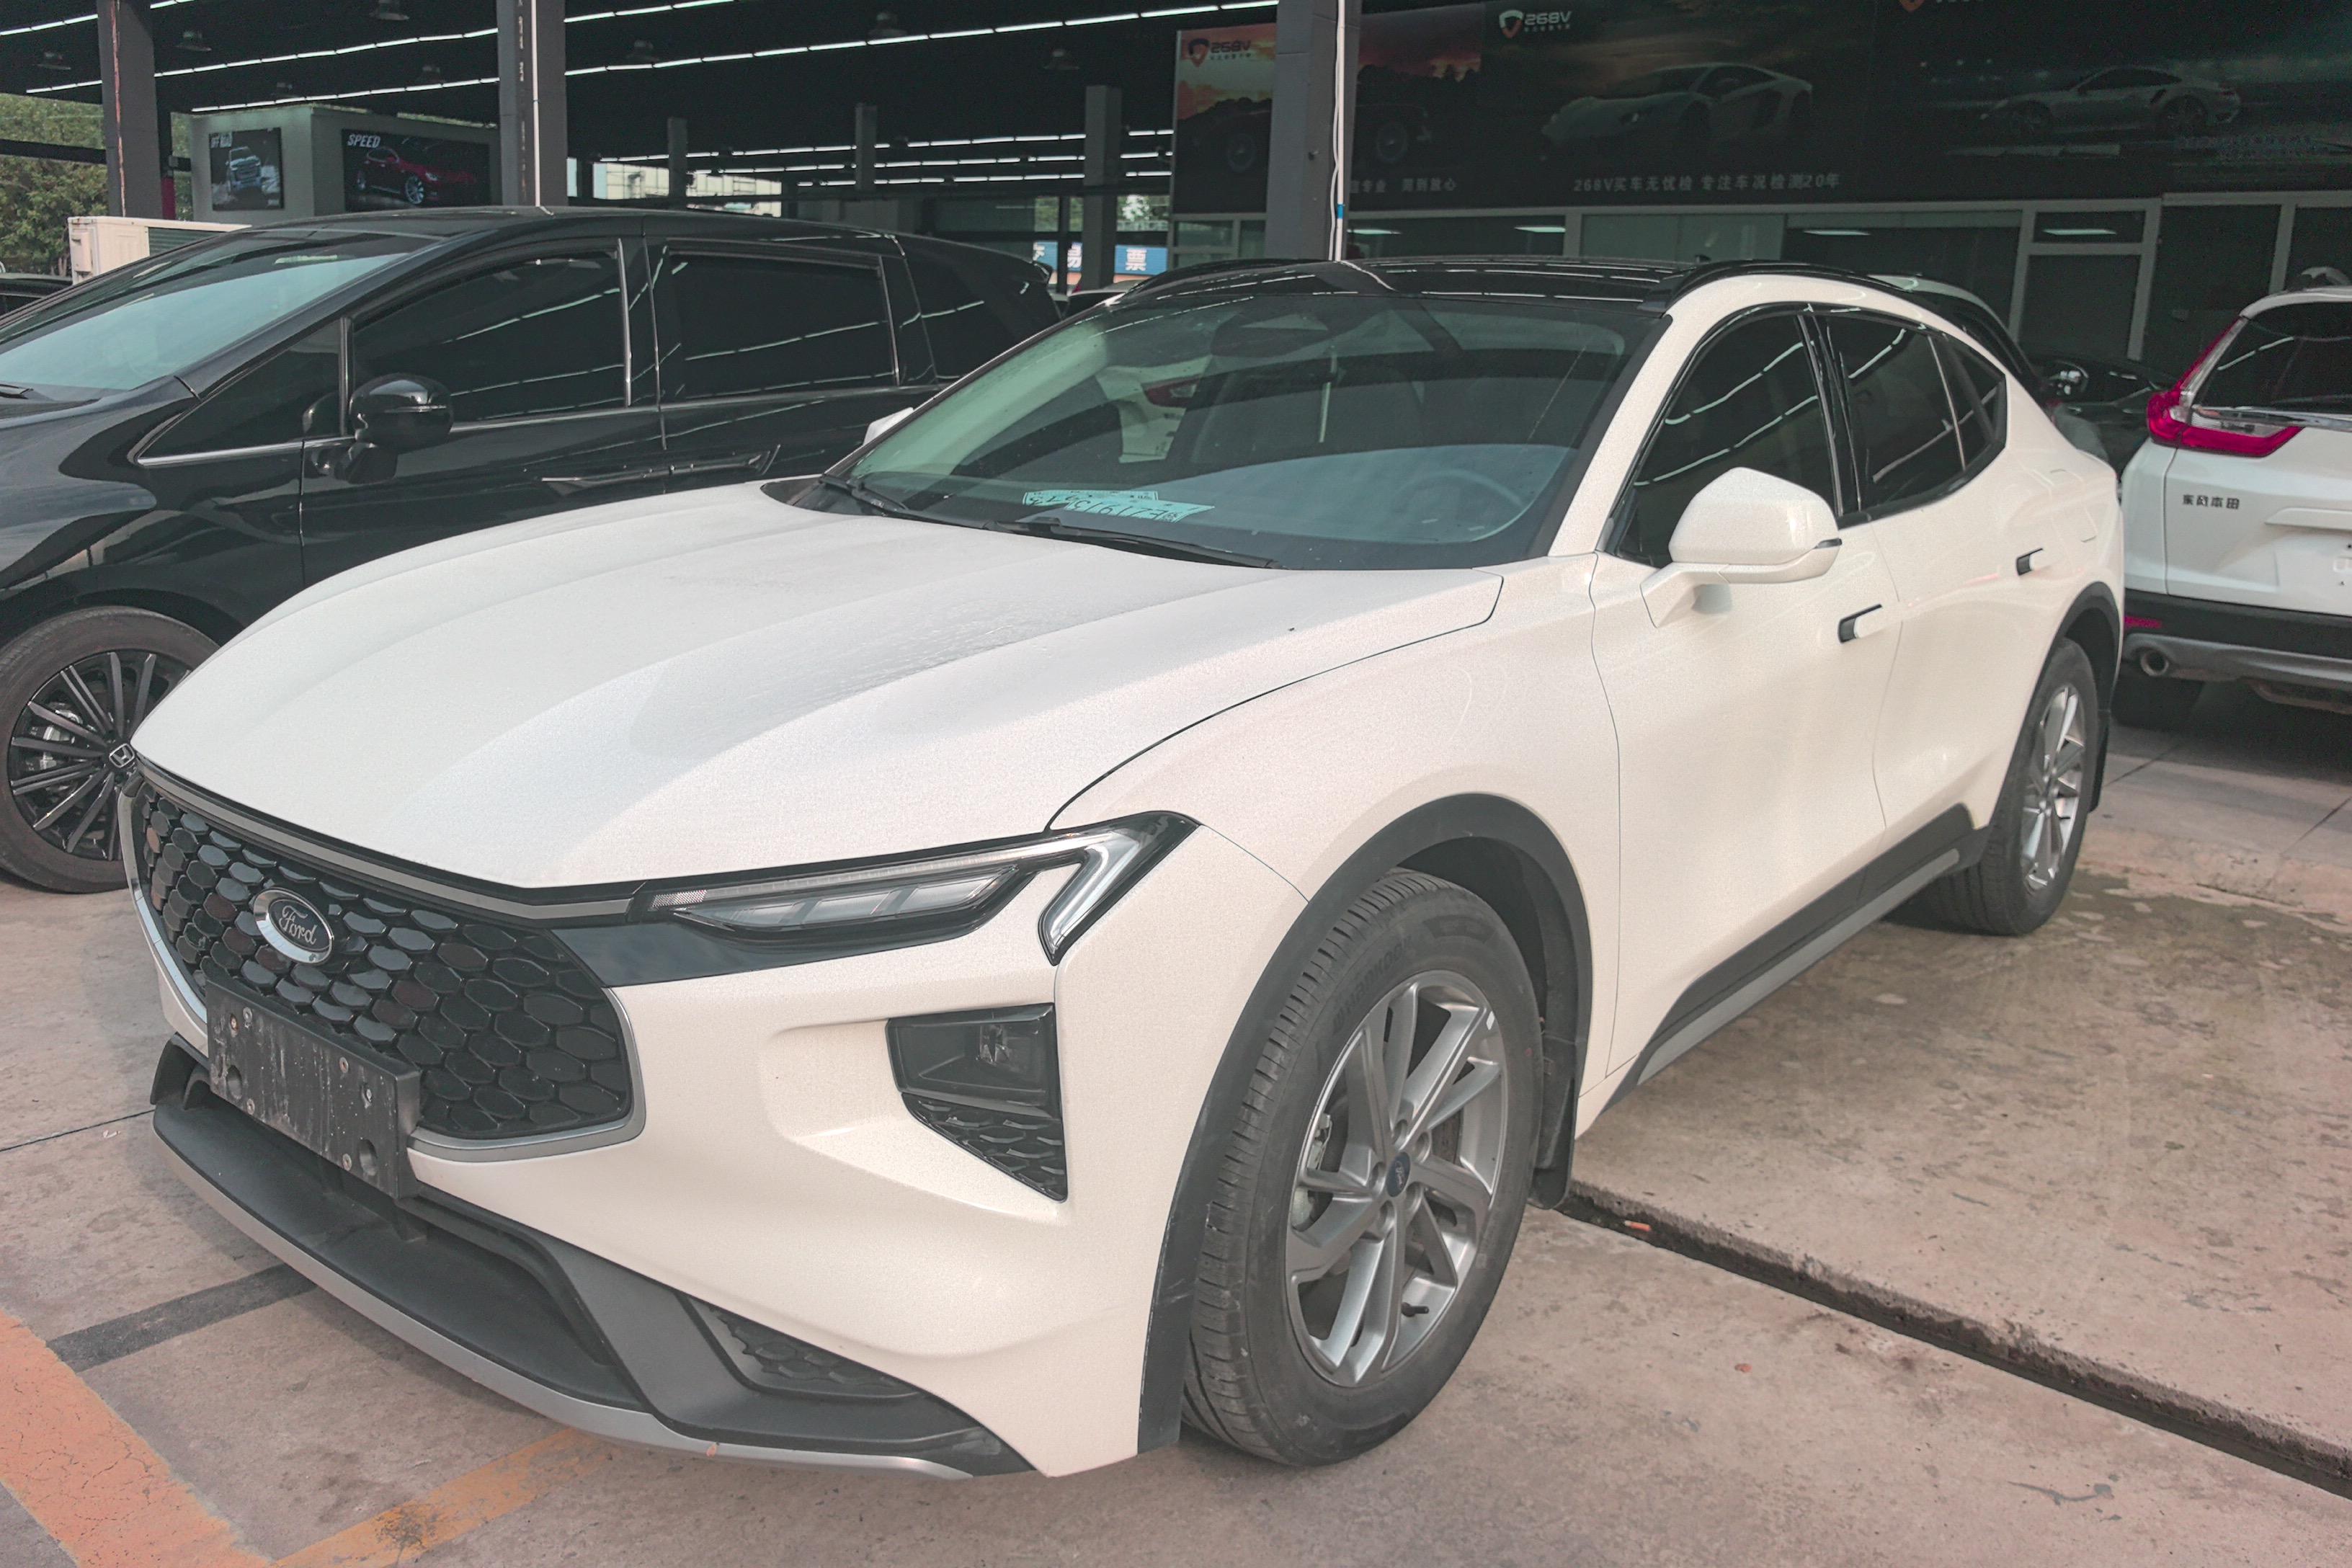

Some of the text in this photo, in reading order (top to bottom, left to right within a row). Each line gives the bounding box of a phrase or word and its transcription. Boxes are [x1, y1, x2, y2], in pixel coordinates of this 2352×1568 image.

[1524, 11, 1572, 25] 268V
[1211, 40, 1251, 53] 268V
[347, 133, 381, 148] SPEED
[1125, 248, 1147, 271] 票
[2183, 494, 2240, 510] 东风本田
[278, 905, 318, 945] Ford
